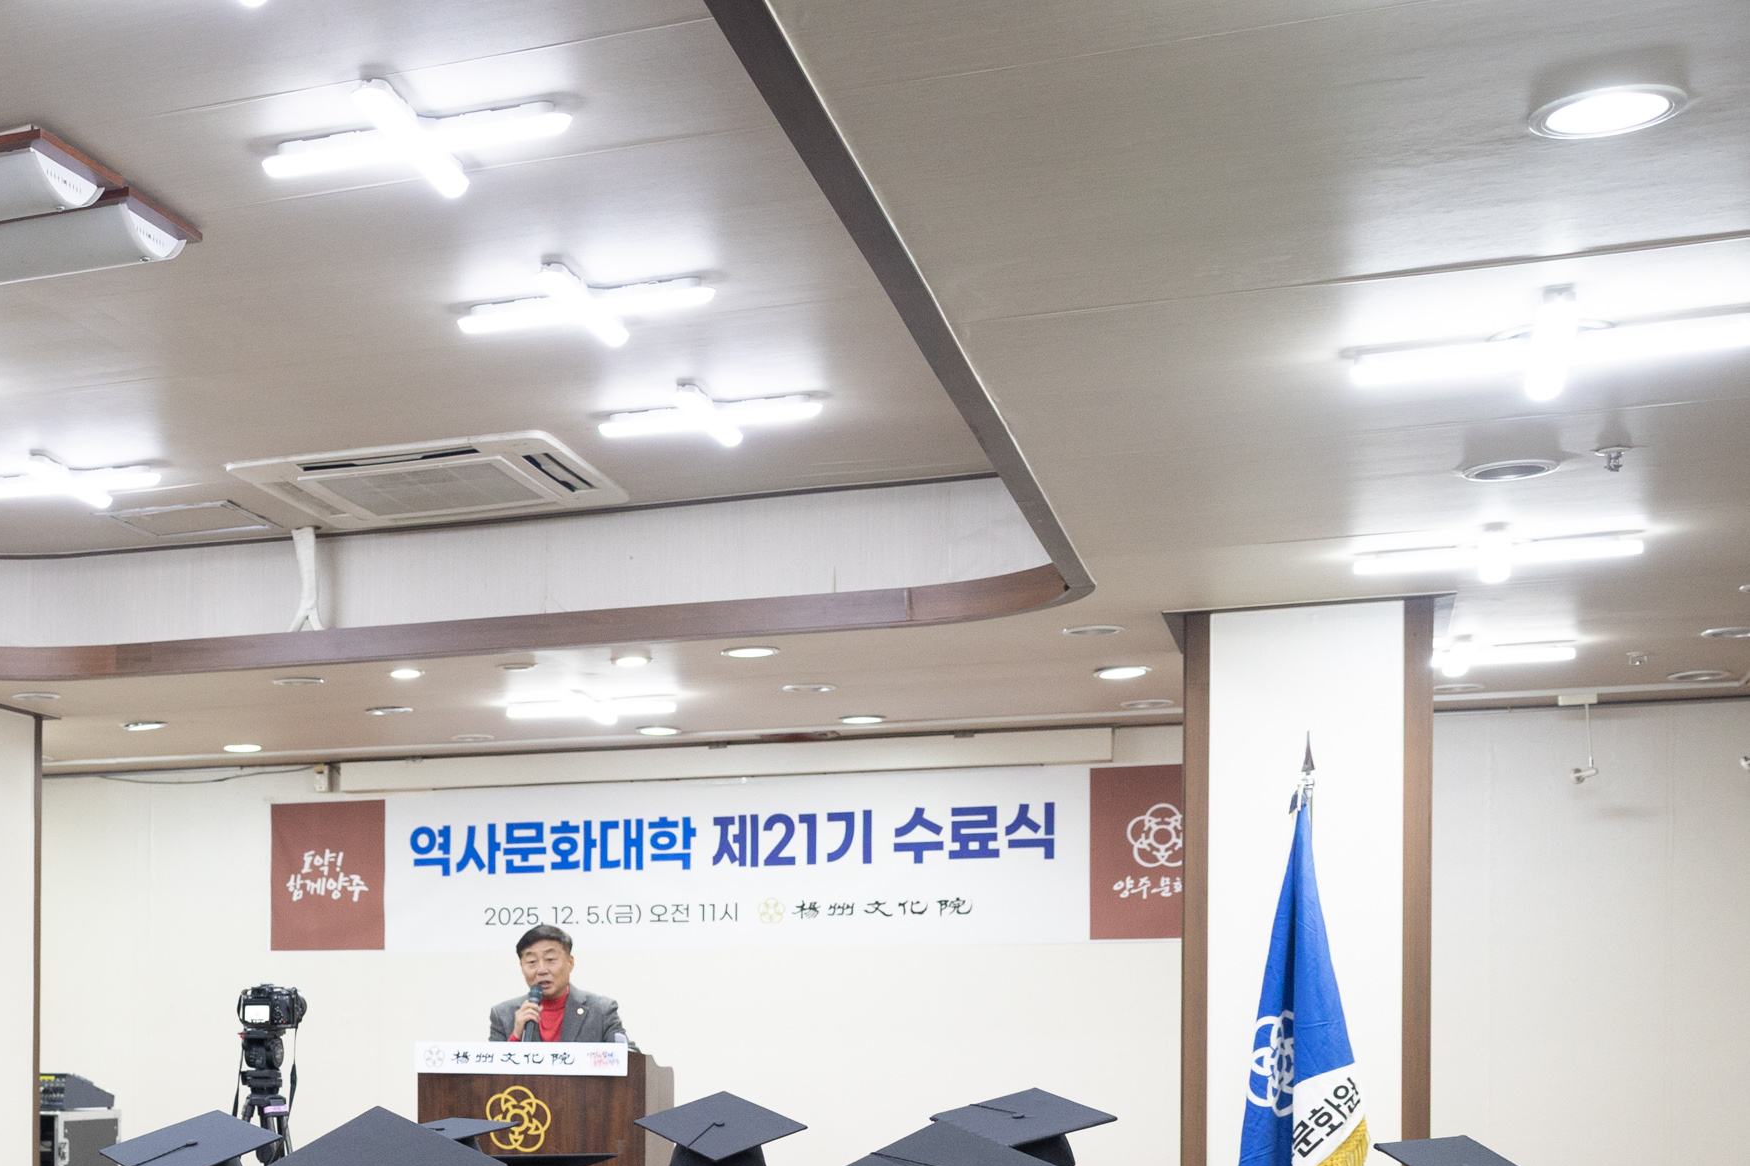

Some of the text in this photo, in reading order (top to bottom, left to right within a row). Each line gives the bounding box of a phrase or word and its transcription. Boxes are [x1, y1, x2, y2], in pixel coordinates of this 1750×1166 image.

[410, 801, 1055, 876] 역사문화대학 제21기 수료식
[301, 848, 344, 876] 도약!
[551, 906, 579, 925] 12.
[649, 904, 690, 923] 오전
[699, 902, 738, 922] 11시
